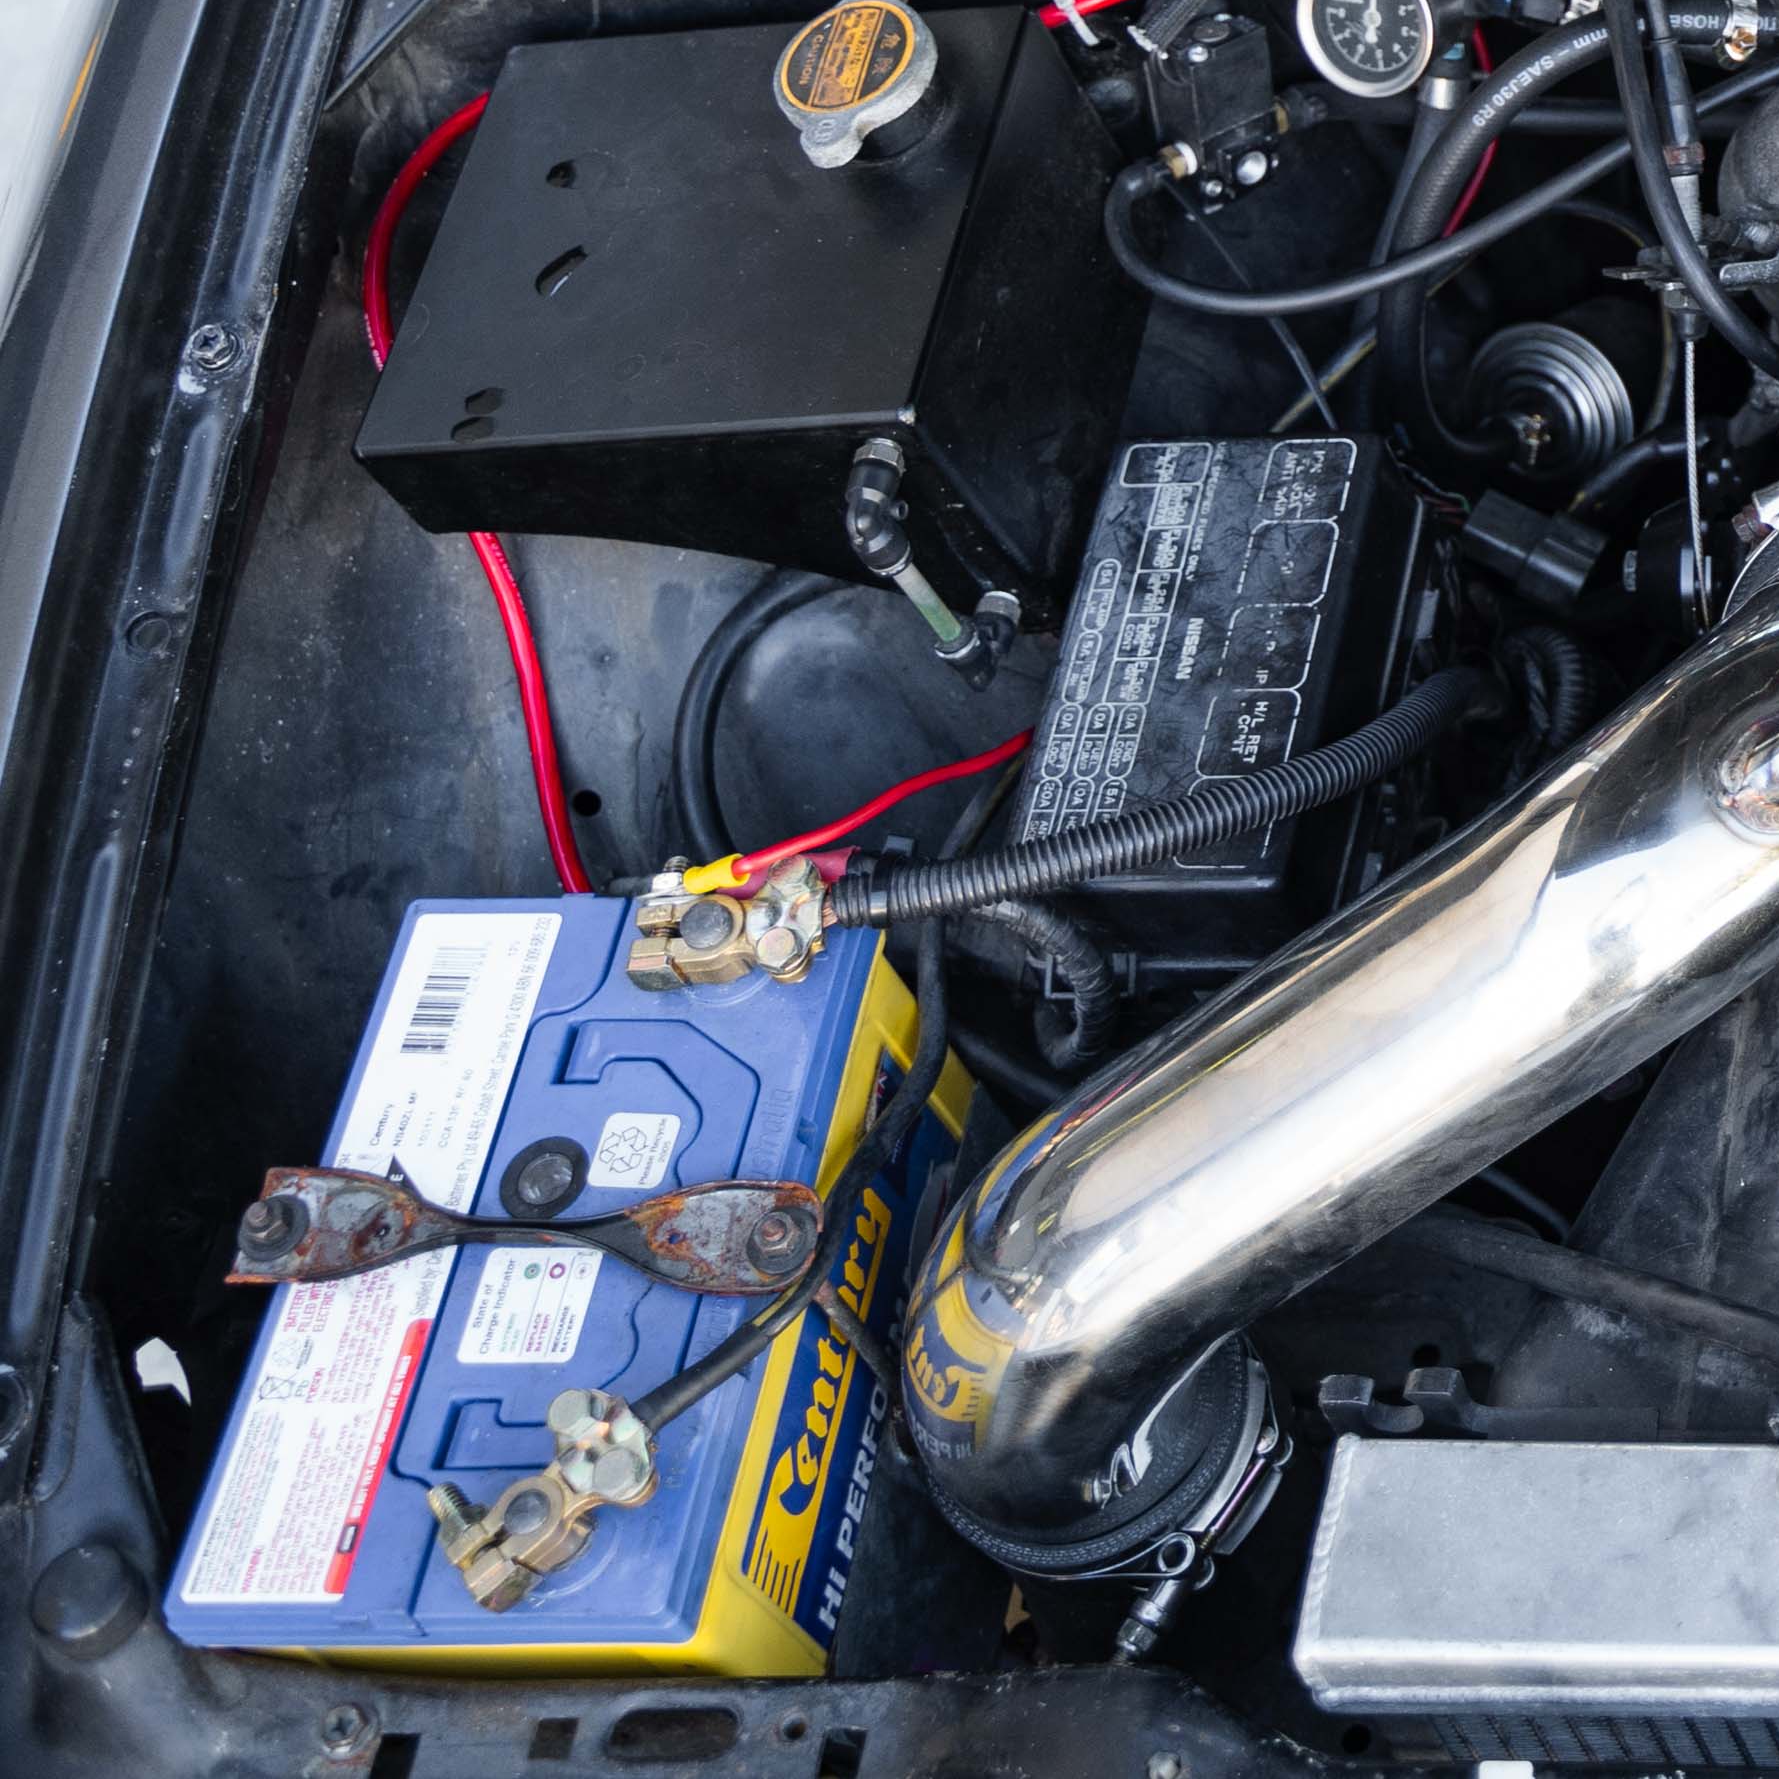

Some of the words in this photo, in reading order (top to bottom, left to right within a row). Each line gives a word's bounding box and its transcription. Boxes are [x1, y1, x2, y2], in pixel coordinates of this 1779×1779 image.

[799, 33, 825, 85] CAUTION
[1491, 54, 1555, 108] SAEJ30
[1469, 96, 1497, 128] R9
[1190, 517, 1208, 551] FUSES
[1182, 554, 1199, 581] ONLY
[1173, 617, 1205, 680] NISSAN
[1059, 707, 1075, 729] 10A
[1091, 707, 1107, 729] 10A
[1123, 706, 1140, 729] 10A
[1249, 700, 1270, 727] H/L
[1077, 740, 1094, 770] PUMP
[1087, 740, 1103, 769] FUEL
[1108, 740, 1124, 768] CONT
[1241, 734, 1261, 764] RET
[1038, 782, 1055, 808] 20A
[1071, 781, 1086, 805] 10A
[1102, 781, 1120, 804] 15A
[367, 1103, 395, 1146] Century
[436, 1125, 454, 1148] CCA
[638, 1155, 654, 1184] Please
[648, 1118, 667, 1152] Recycle
[409, 1281, 435, 1315] Supplied
[444, 1171, 470, 1205] Batteries
[306, 1282, 325, 1300] WIT
[471, 1299, 489, 1328] State
[481, 1284, 494, 1295] of
[477, 1312, 501, 1354] Charge
[492, 1258, 516, 1308] Indicator
[295, 1302, 318, 1332] FILLED
[310, 1289, 338, 1332] ELECTRIC
[524, 1313, 543, 1352] REPLACE
[533, 1313, 552, 1351] BATTERY
[549, 1305, 571, 1352] RECHARGE
[559, 1314, 577, 1352] BATTERY
[292, 1379, 310, 1397] Pb
[836, 1383, 892, 1560] PERFO
